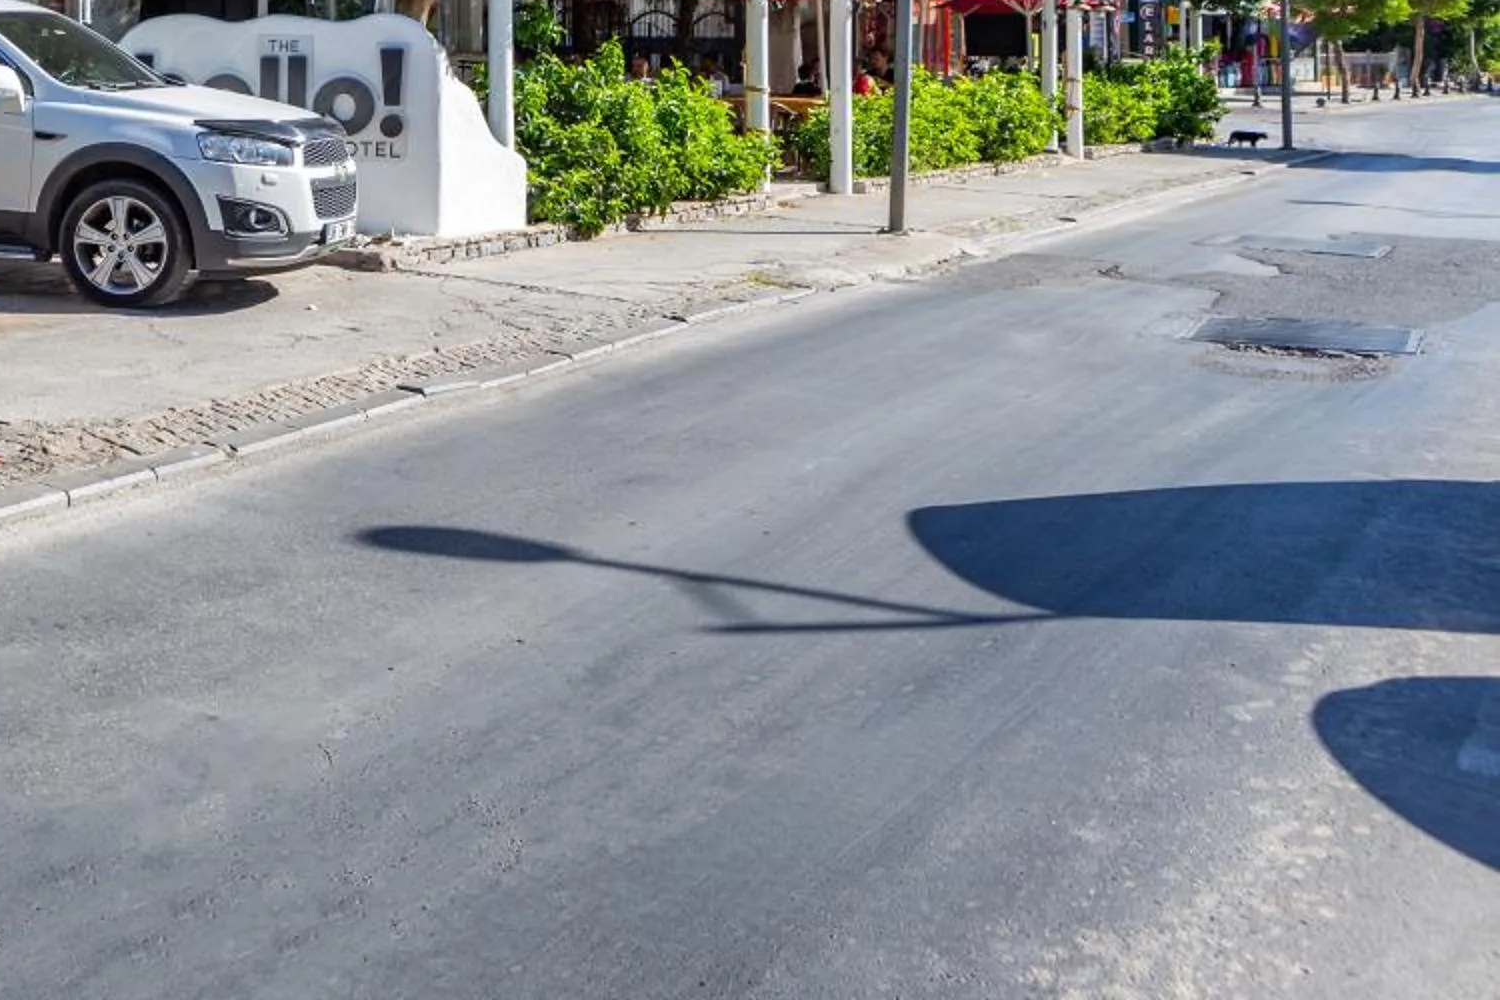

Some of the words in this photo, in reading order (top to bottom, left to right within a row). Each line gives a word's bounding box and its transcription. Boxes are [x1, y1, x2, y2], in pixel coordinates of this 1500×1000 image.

[268, 39, 300, 53] THE
[134, 47, 404, 138] llo!
[345, 140, 401, 159] OTEL
